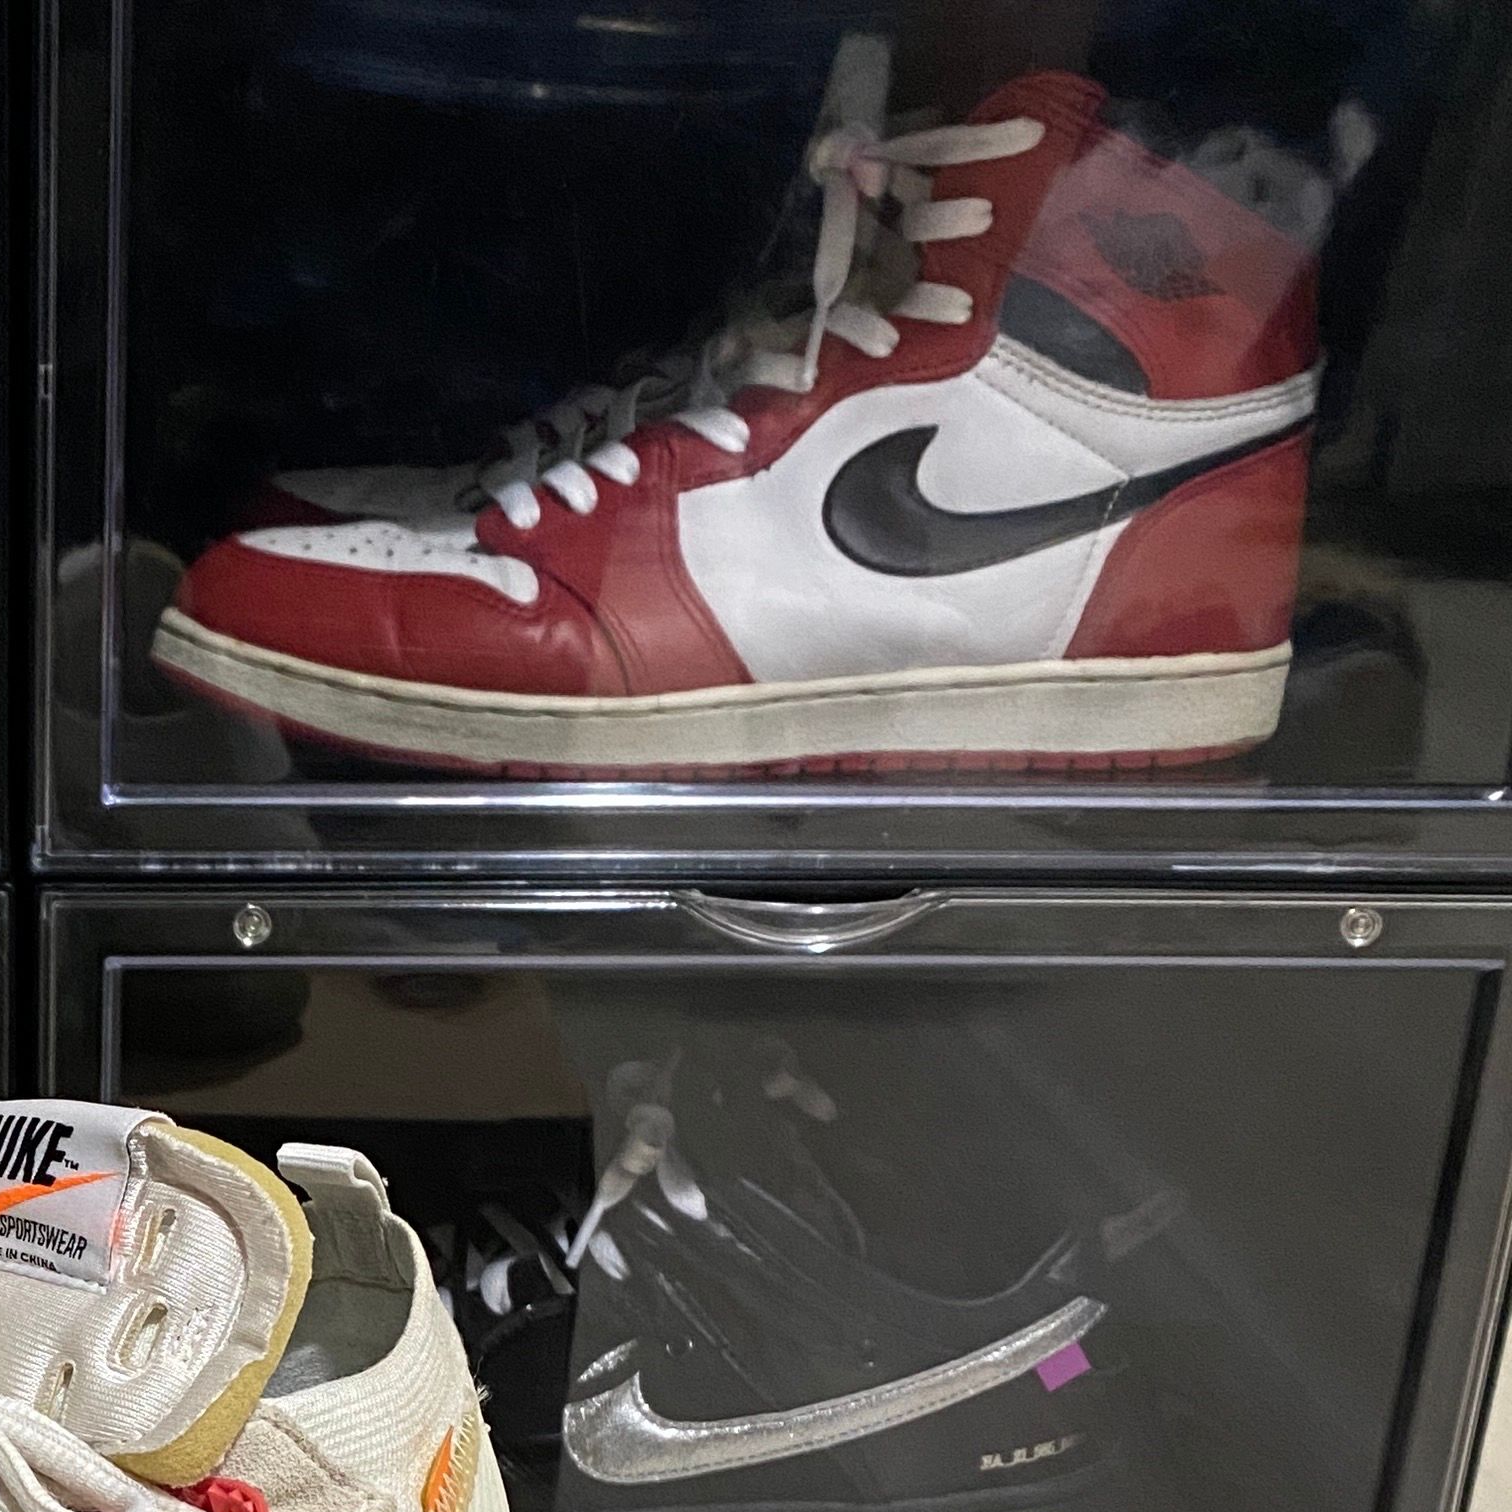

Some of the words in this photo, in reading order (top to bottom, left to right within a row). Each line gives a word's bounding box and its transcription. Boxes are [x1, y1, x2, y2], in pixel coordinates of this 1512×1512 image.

[0, 1214, 88, 1260] SPORTSWEAR
[5, 1248, 19, 1260] IN
[20, 1253, 58, 1273] CHINA
